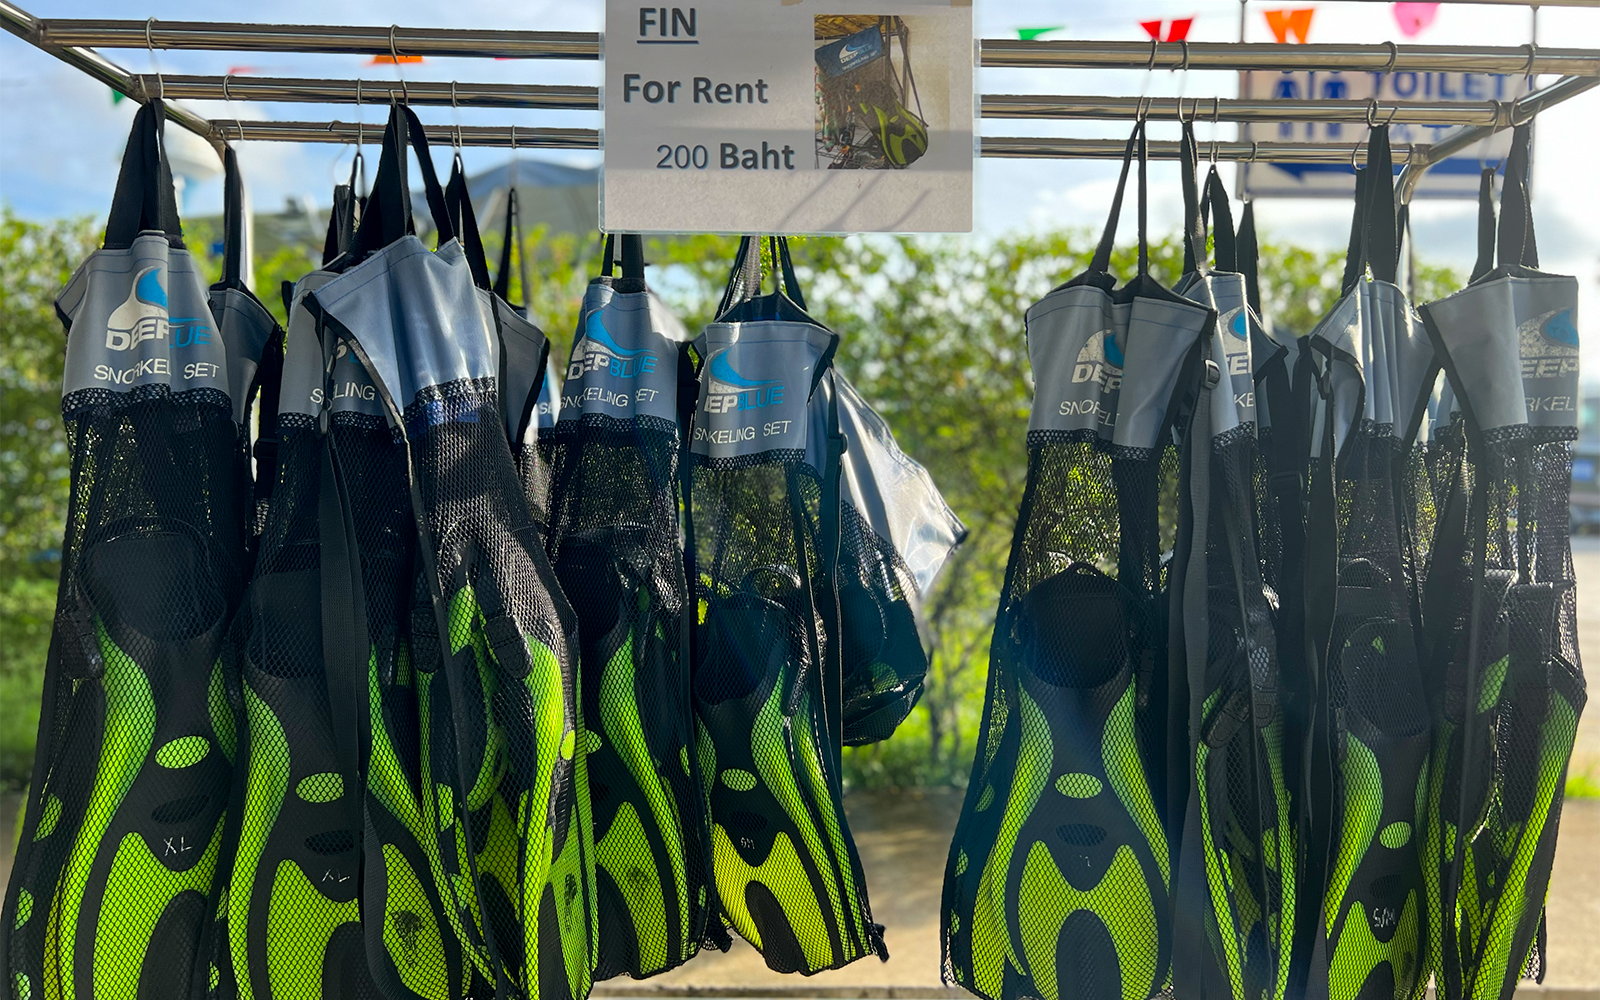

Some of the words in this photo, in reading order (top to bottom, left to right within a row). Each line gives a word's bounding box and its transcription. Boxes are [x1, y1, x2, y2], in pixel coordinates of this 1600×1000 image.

[639, 7, 697, 38] FIN
[623, 73, 682, 104] For
[693, 77, 769, 104] Rent
[1367, 71, 1513, 100] TOILET
[656, 144, 710, 170] 200
[719, 141, 796, 170] Baht
[183, 362, 220, 380] SET
[762, 420, 792, 437] SET
[163, 836, 193, 857] XL
